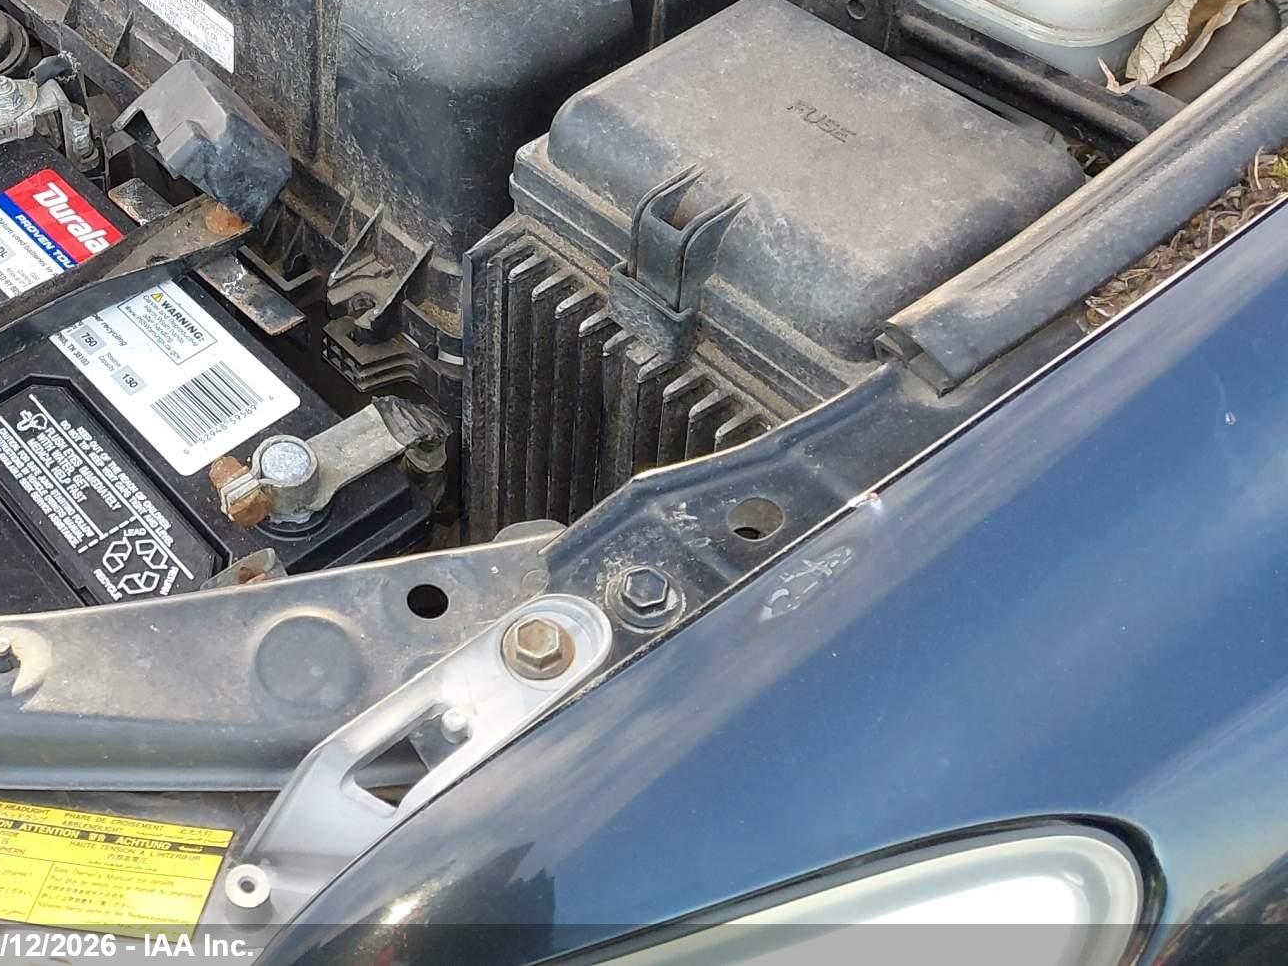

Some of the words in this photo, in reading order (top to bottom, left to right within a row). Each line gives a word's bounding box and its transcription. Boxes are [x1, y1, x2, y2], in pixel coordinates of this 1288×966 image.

[786, 99, 857, 143] FUSE
[16, 215, 54, 249] PROVEN
[12, 234, 28, 246] used
[24, 245, 46, 267] batteries
[101, 322, 127, 346] recycling
[142, 314, 155, 323] after
[153, 323, 173, 343] handling
[143, 295, 160, 310] Cancer
[158, 310, 170, 319] and
[168, 318, 198, 346] Reproductive
[162, 301, 203, 341] WARNING:
[81, 332, 97, 347] 750
[169, 329, 184, 344] hands
[67, 343, 76, 352] TN
[73, 351, 90, 366] 38103
[123, 374, 138, 388] 130
[27, 438, 54, 467] MEDICAL
[51, 466, 71, 484] HELP
[67, 484, 87, 502] FAST
[37, 433, 55, 452] WITH
[73, 474, 90, 489] GET
[45, 427, 68, 450] FLUSH
[63, 448, 83, 467] EYES
[79, 466, 121, 509] IMMEDIATELY
[60, 420, 71, 430] DO
[68, 429, 82, 442] NOT
[89, 452, 105, 467] KEEP
[102, 466, 118, 482] VENT
[115, 481, 131, 498] CAPS
[129, 496, 147, 514] TIGHT
[144, 514, 158, 528] AND
[77, 426, 92, 441] KEEP
[89, 441, 103, 453] OUT
[100, 453, 111, 461] OF
[108, 461, 122, 475] THE
[118, 473, 138, 493] REACH
[134, 491, 147, 503] OF
[17, 450, 30, 463] FOR
[27, 461, 42, 476] SAFE
[50, 489, 75, 516] STARTING
[72, 514, 94, 537] FOLLOW
[19, 478, 36, 493] SEEK
[31, 491, 52, 514] SERVICE
[27, 474, 48, 496] VEHICLE
[123, 528, 147, 537] LEAD
[93, 568, 122, 601] RECYCLE
[161, 565, 179, 595] RETURN
[4, 805, 50, 814] HEADLIGHT
[64, 813, 91, 821] PHARE
[111, 819, 164, 831] CROISEMENT
[20, 823, 79, 838] ATTENTION
[116, 837, 171, 850] ACHTUNG
[70, 841, 96, 849] HAUTE
[101, 845, 136, 854] TENSION
